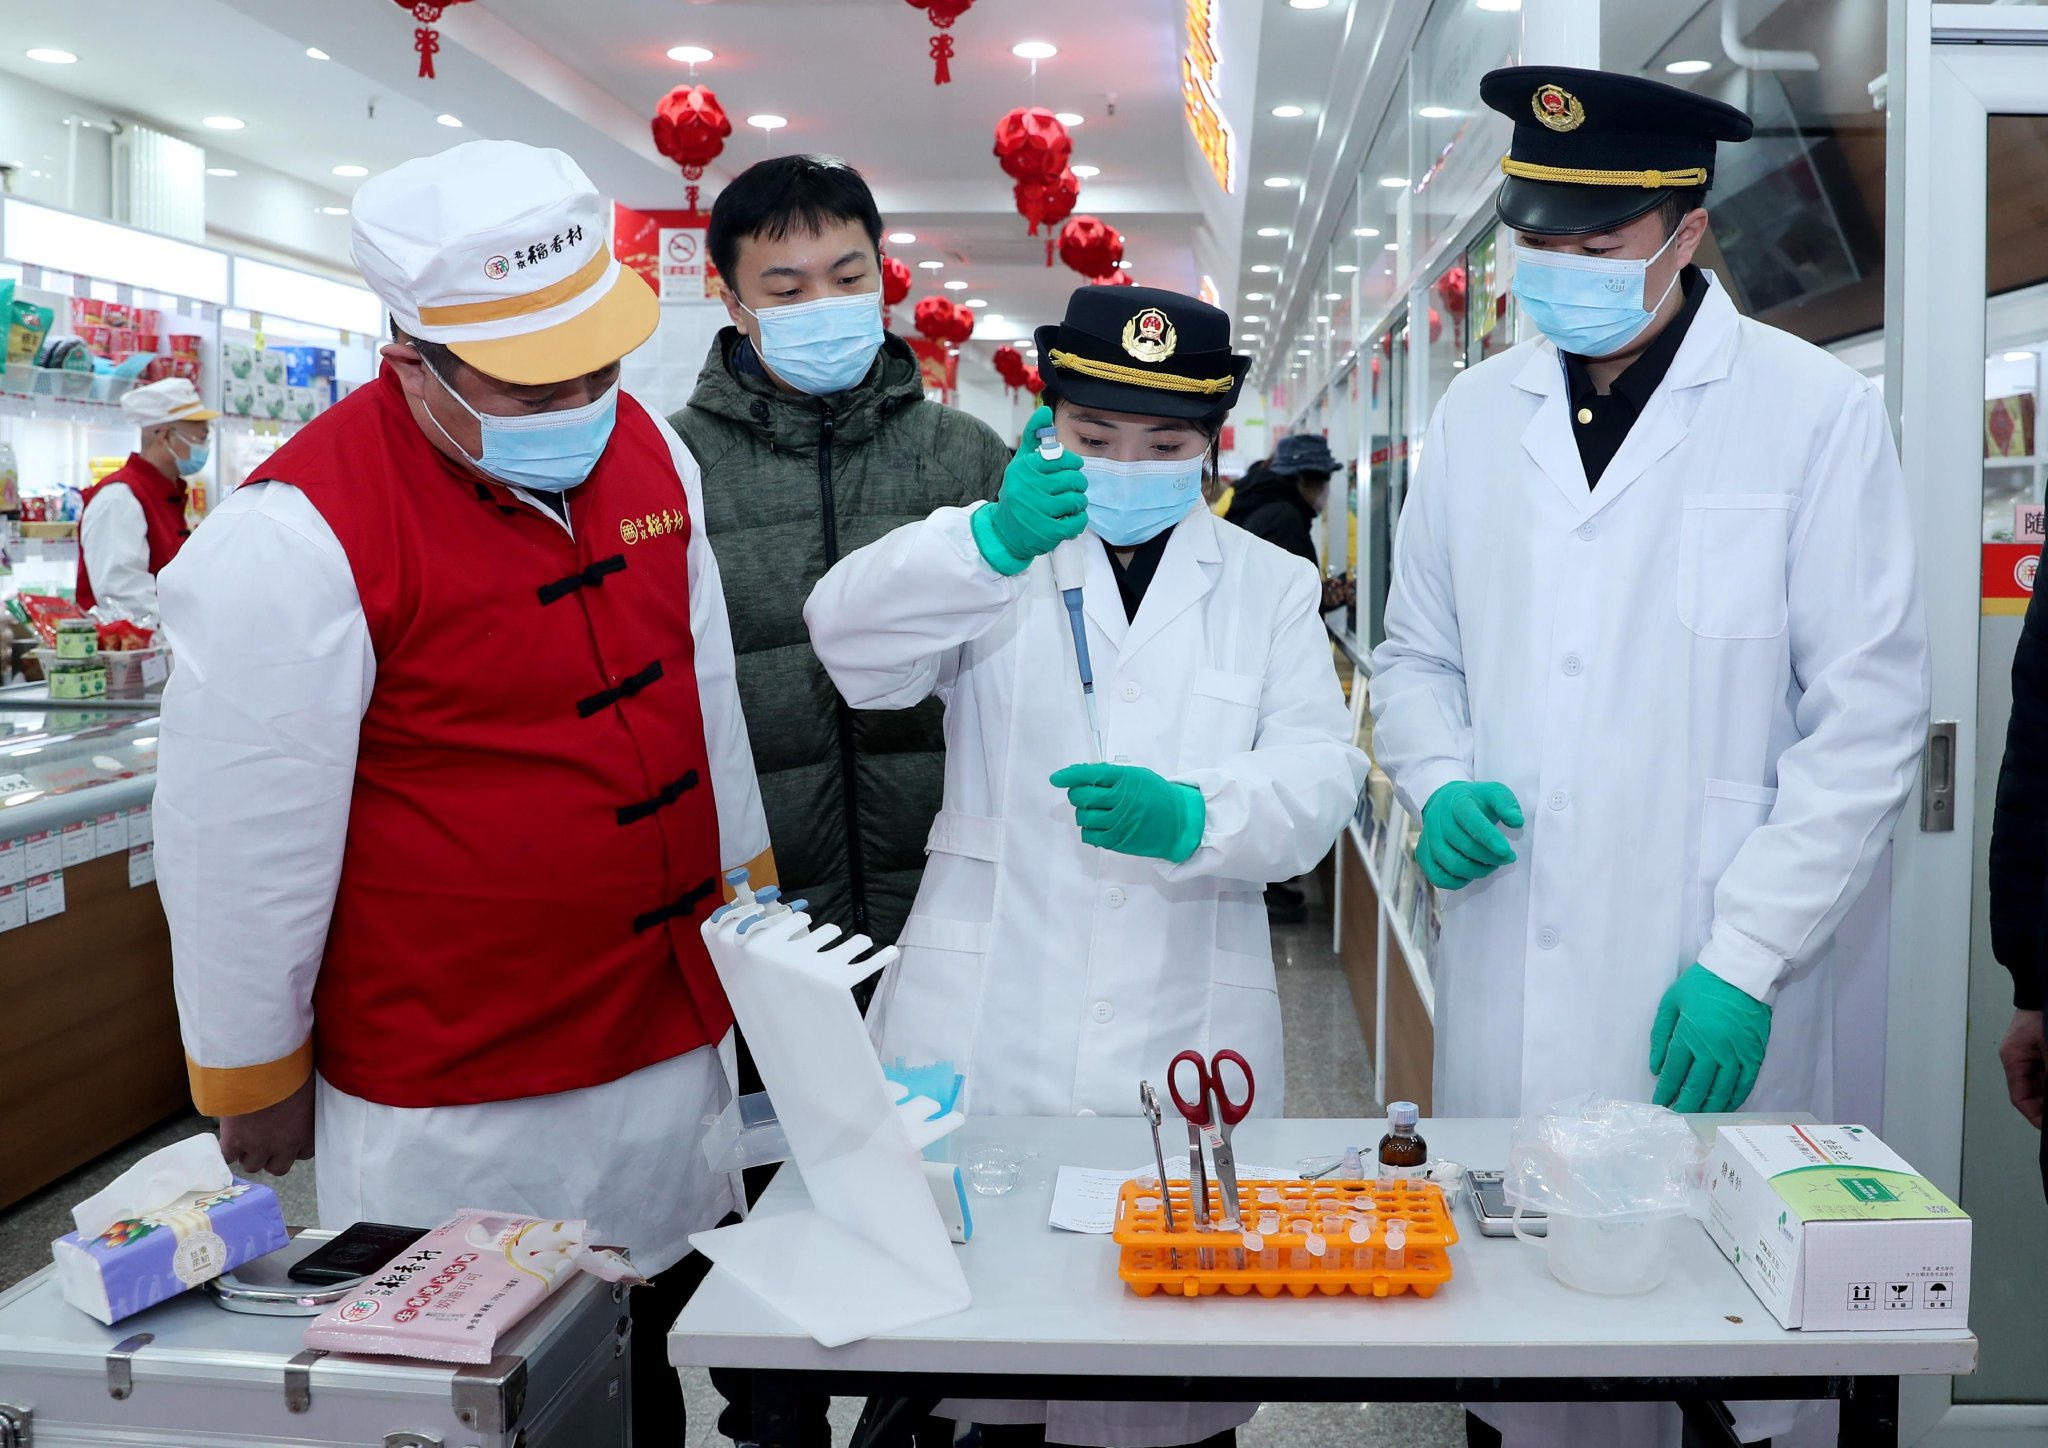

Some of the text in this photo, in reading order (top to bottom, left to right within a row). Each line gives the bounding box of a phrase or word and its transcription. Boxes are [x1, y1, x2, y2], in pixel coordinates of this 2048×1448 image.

[514, 224, 583, 270] 北京 稻香村
[636, 508, 684, 540] 北京 稻香村
[374, 1249, 443, 1289] 稻香村
